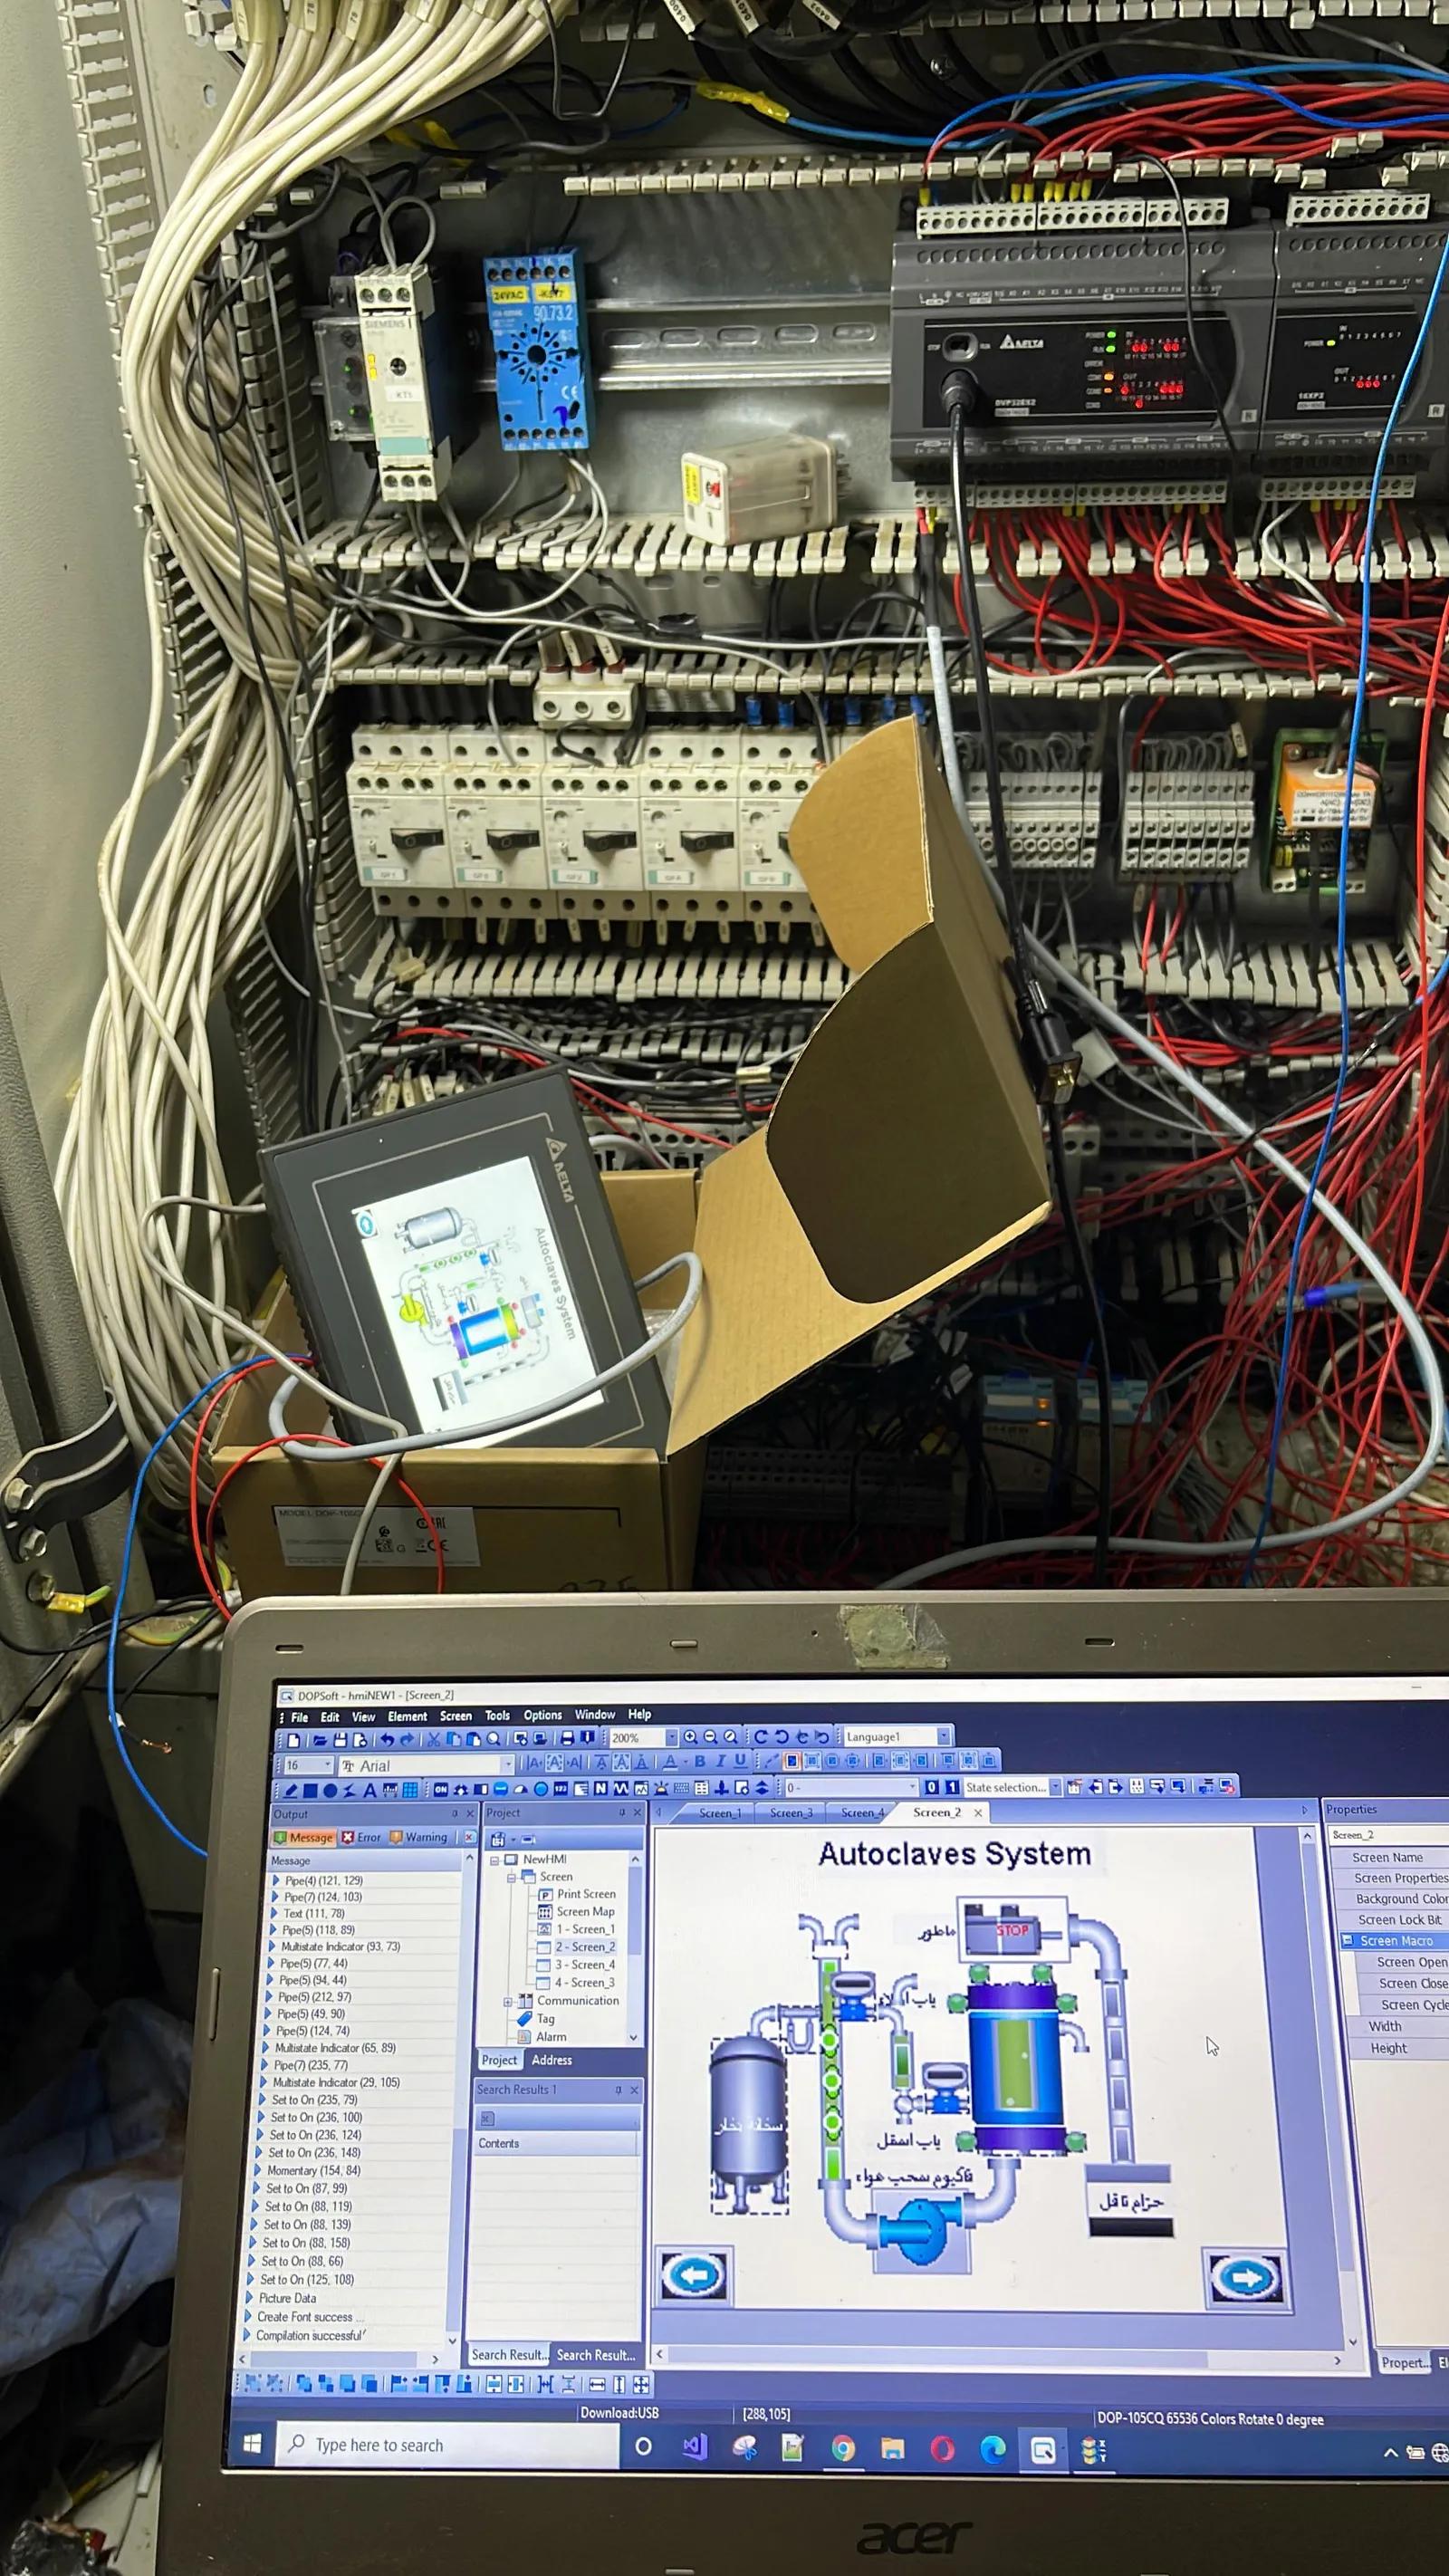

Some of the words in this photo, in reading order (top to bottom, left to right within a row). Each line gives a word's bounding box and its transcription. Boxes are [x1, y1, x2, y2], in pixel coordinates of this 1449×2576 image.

[734, 0, 752, 21] 040
[810, 3, 831, 22] 0402
[533, 304, 573, 322] 90.73.2
[365, 319, 406, 329] SIEMENS
[1015, 340, 1044, 350] DELTA
[554, 1160, 575, 1204] DELTA
[534, 1226, 562, 1293] Autoclaves
[557, 1294, 577, 1341] System
[298, 1691, 339, 1701] DOPSoft
[349, 1690, 395, 1700] hmiNEW1
[406, 1690, 454, 1702] [Screen_2]
[291, 1712, 308, 1723] File
[321, 1712, 340, 1723] Edit
[352, 1711, 376, 1722] View
[389, 1711, 427, 1722] Element
[440, 1710, 472, 1721] Screen
[485, 1710, 510, 1721] Tools
[523, 1709, 562, 1723] Options
[575, 1709, 616, 1719] Window
[629, 1708, 651, 1722] Help
[612, 1733, 639, 1743] 200%
[848, 1732, 899, 1744] Language1
[284, 1758, 298, 1770] 16
[360, 1760, 390, 1773] Arial
[964, 1783, 992, 1794] State
[993, 1783, 1046, 1793] selection...
[273, 1809, 308, 1821] Output
[486, 1808, 520, 1821] Project
[697, 1808, 744, 1821] Screen_1
[768, 1808, 815, 1821] Screen_3
[839, 1808, 887, 1821] Screen_4
[914, 1807, 961, 1819] Screen_2
[1327, 1804, 1377, 1817] Properties
[291, 1832, 333, 1845] Message
[358, 1832, 380, 1845] Error
[404, 1832, 447, 1846] Warning
[1333, 1830, 1374, 1841] Screen_2
[271, 1856, 311, 1868] Message
[523, 1854, 567, 1864] NewHMI
[819, 1841, 975, 1866] Autoclaves
[986, 1841, 1091, 1871] System
[1353, 1852, 1389, 1862] Screen
[1393, 1852, 1423, 1862] Name
[285, 1876, 316, 1888] Pipe(4)
[318, 1875, 341, 1887] (121,
[345, 1875, 363, 1887] 129)
[541, 1871, 573, 1881] Screen
[1355, 1873, 1392, 1883] Screen
[1396, 1873, 1449, 1885] Properties
[558, 1889, 581, 1898] Print
[583, 1889, 616, 1898] Screen
[1357, 1893, 1419, 1906] Background
[1423, 1893, 1449, 1904] Color
[557, 1907, 590, 1917] Screen
[592, 1906, 615, 1919] Map
[1358, 1915, 1396, 1925] Screen
[1399, 1914, 1425, 1925] Lock
[1427, 1915, 1443, 1925] Bit
[558, 1924, 561, 1934] 1
[572, 1924, 615, 1936] Screen_1
[917, 1925, 956, 1942] ماطور
[994, 1924, 1030, 1936] STOP
[282, 1941, 323, 1951] Multistate
[326, 1941, 364, 1951] Indicator
[367, 1941, 383, 1953] (93,
[386, 1941, 400, 1953] 73)
[1361, 1936, 1398, 1946] Screen
[1402, 1936, 1434, 1946] Macro
[556, 1941, 562, 1952] 2
[572, 1941, 615, 1954] Screen_2
[556, 1959, 561, 1970] 3
[571, 1959, 615, 1972] Screen_4
[1377, 1956, 1415, 1967] Screen
[1419, 1957, 1449, 1969] Open
[555, 1977, 561, 1987] 4
[571, 1977, 615, 1989] Screen_3
[1379, 1978, 1417, 1989] Screen
[1421, 1978, 1449, 1989] Close
[537, 1995, 619, 2005] Communication
[1382, 2000, 1419, 2010] Screen
[1424, 2000, 1449, 2013] Cycle
[537, 2014, 555, 2026] Tag
[1368, 2021, 1402, 2032] Width
[536, 2032, 567, 2042] Alarm
[1371, 2043, 1408, 2055] Height
[482, 2054, 517, 2068] Project
[532, 2054, 572, 2065] Address
[477, 2084, 511, 2094] Search
[513, 2084, 549, 2094] Results
[552, 2084, 556, 2095] 1
[272, 2094, 287, 2105] Set
[289, 2095, 299, 2105] to
[301, 2094, 314, 2105] On
[317, 2094, 340, 2106] (235,
[343, 2094, 358, 2107] 79)
[479, 2138, 520, 2148] Contents
[856, 2167, 885, 2188] هواء
[888, 2174, 930, 2187] سحب
[259, 2292, 292, 2303] Picture
[294, 2292, 316, 2303] Data
[473, 2349, 506, 2360] Search
[510, 2348, 552, 2361] Result...
[557, 2349, 591, 2360] Search
[595, 2349, 636, 2360] Result...
[1382, 2356, 1433, 2371] Propert...
[581, 2406, 659, 2418] Download:USB
[744, 2408, 791, 2422] [288,105]
[1098, 2411, 1165, 2425] DOP-105CQ
[1166, 2412, 1198, 2425] 65536
[1201, 2412, 1236, 2425] Colors
[1238, 2413, 1274, 2425] Rotate
[1276, 2413, 1283, 2425] 0
[1286, 2413, 1324, 2428] degree
[316, 2437, 347, 2455] Type
[350, 2438, 379, 2452] here
[384, 2439, 398, 2452] to
[401, 2438, 443, 2452] search
[857, 2522, 974, 2555] acer
